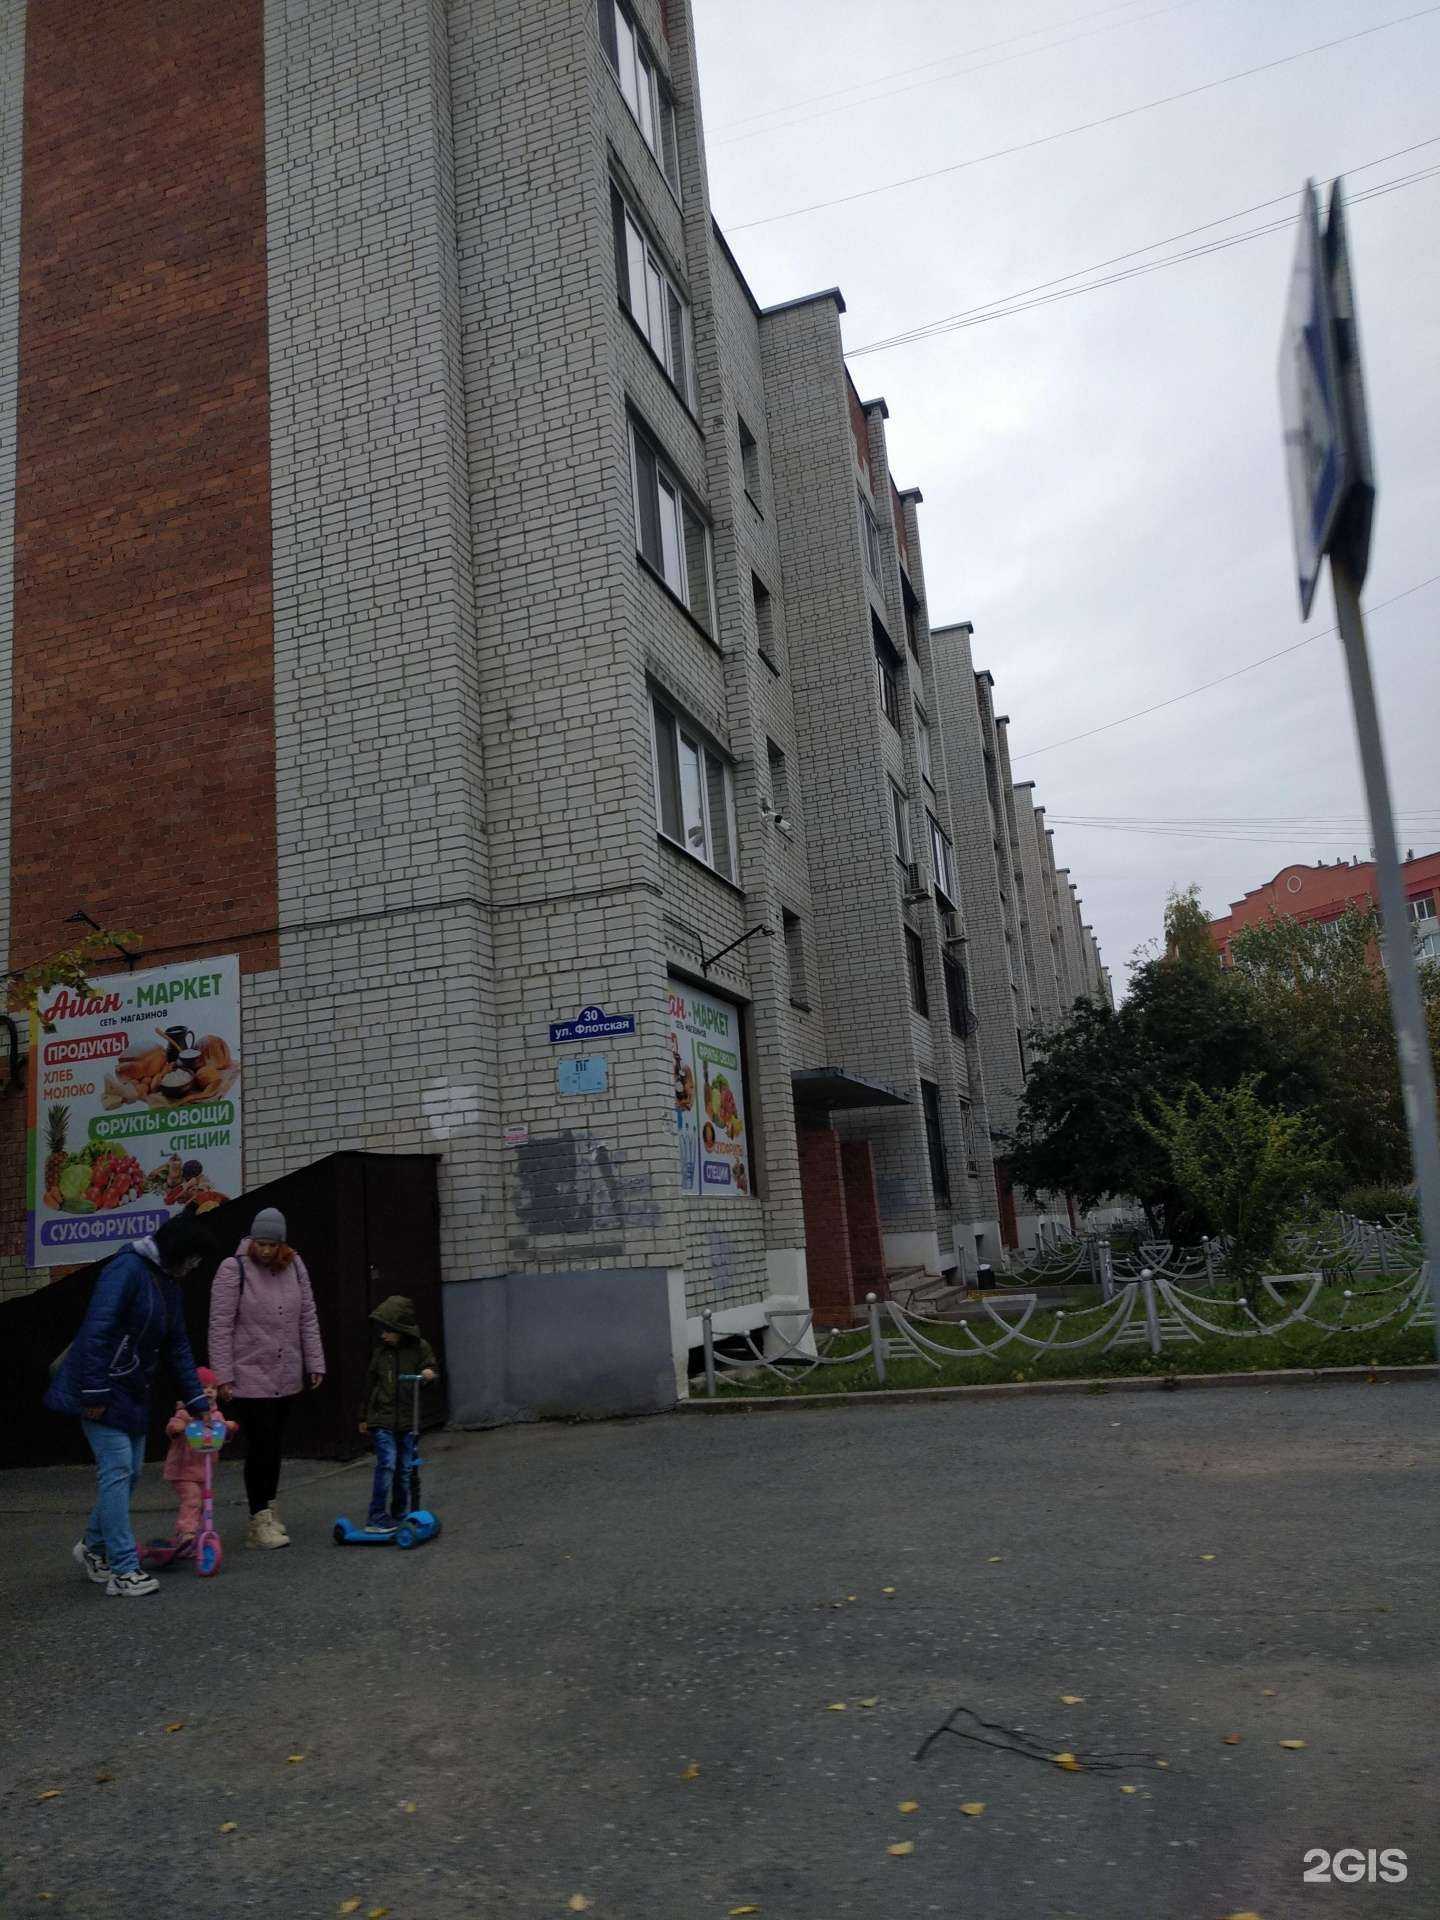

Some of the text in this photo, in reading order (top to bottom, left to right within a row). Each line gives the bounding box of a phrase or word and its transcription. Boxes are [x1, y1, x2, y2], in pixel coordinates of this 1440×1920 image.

[99, 1009, 168, 1027] СЕТЬ МАГАЗИНОВ
[584, 1010, 598, 1022] 30
[555, 1020, 629, 1039] ул. Флотская
[47, 1036, 126, 1061] ПРОДУКТЫ
[43, 1069, 73, 1085] ХЛЕБ
[43, 1083, 96, 1100] МОЛОКО
[169, 1130, 231, 1151] СПЕЦИИ
[50, 1214, 161, 1242] СУХОФРУКТЫ
